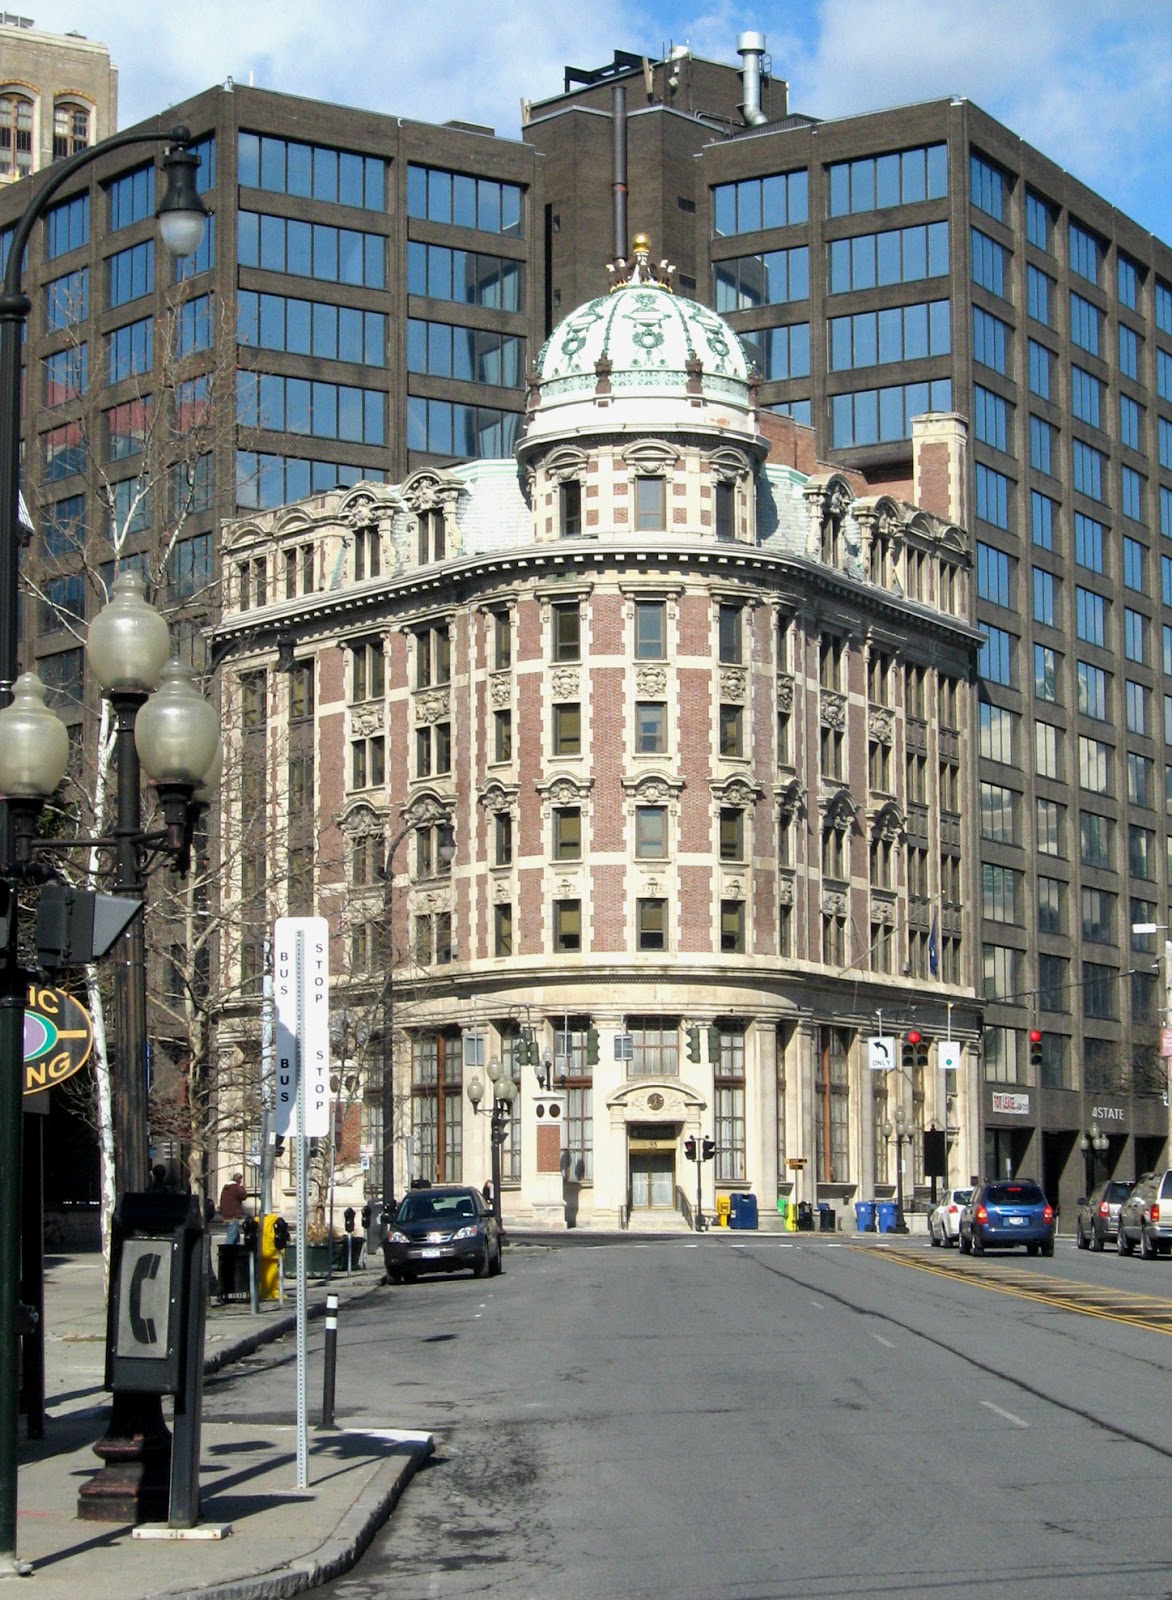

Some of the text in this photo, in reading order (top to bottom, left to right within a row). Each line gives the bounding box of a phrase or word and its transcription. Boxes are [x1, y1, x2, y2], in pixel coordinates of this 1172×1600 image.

[280, 943, 324, 1003] BUS STOP
[29, 985, 59, 1014] IC
[26, 1051, 71, 1088] NG
[280, 1050, 325, 1110] BUS STOP
[872, 1059, 892, 1067] ONLY
